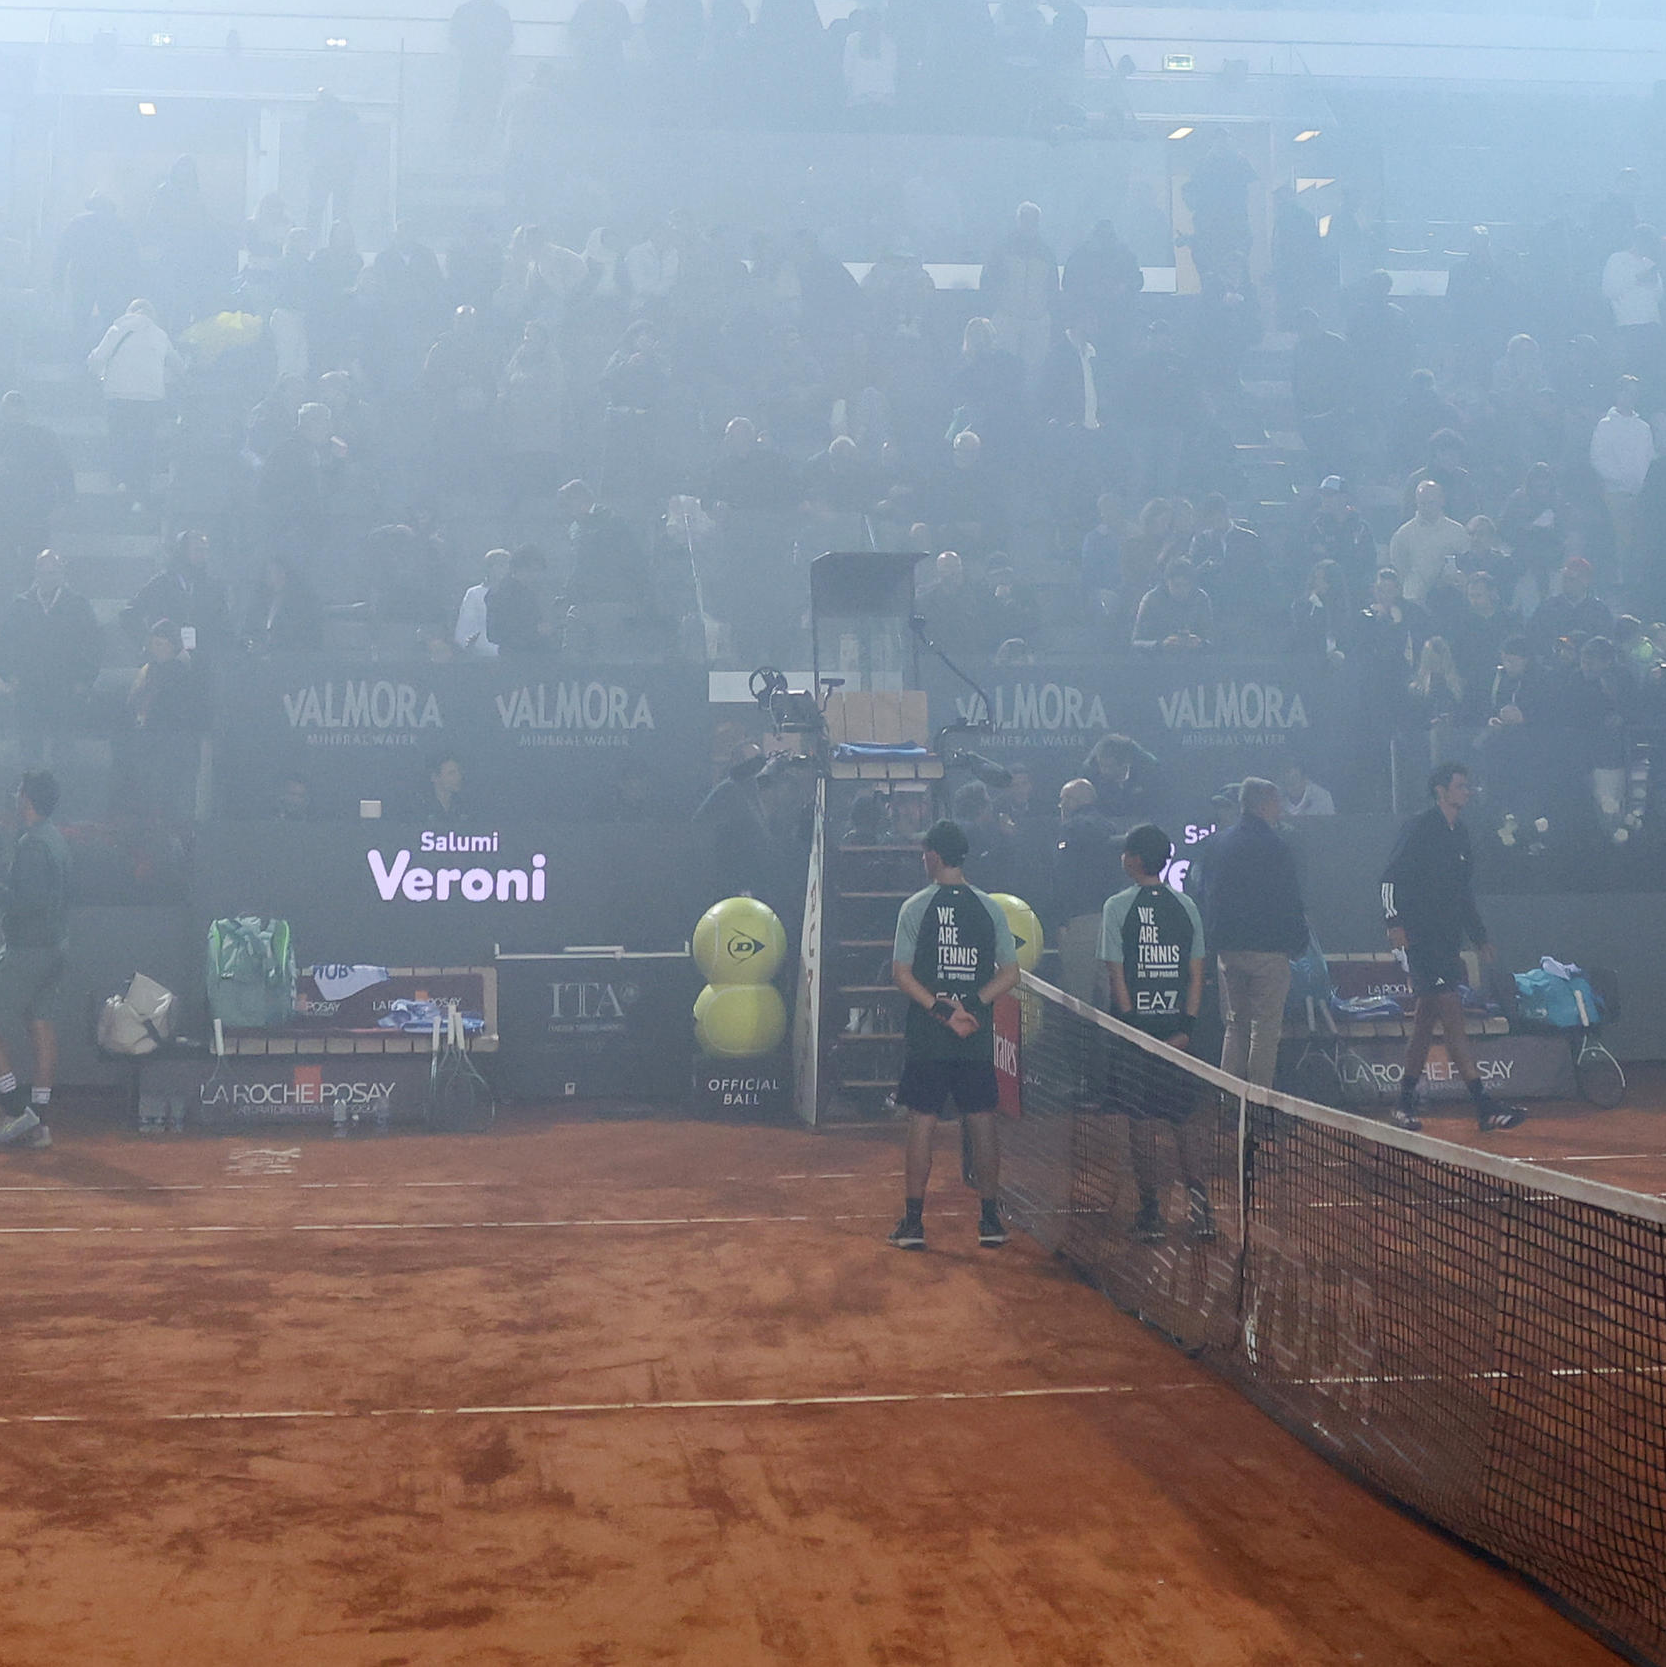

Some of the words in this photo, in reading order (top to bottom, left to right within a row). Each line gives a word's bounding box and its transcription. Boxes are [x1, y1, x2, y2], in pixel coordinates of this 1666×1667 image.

[282, 679, 444, 729] VALMORA
[494, 681, 656, 730] VALMORA
[955, 682, 1110, 730] VALMORA
[1157, 681, 1309, 729] VALMORA
[420, 830, 499, 852] Salumi
[366, 848, 548, 902] Veroni
[937, 906, 955, 926] WE
[1137, 906, 1155, 925] WE
[938, 926, 959, 945] ARE
[1139, 926, 1159, 944] ARE
[938, 946, 978, 966] TENNIS
[1138, 945, 1180, 963] TENNIS
[1367, 984, 1381, 995] LA
[1382, 985, 1412, 995] ROCH
[1136, 990, 1179, 1010] EA7
[992, 1022, 1017, 1077] irates
[1372, 1061, 1447, 1083] ROHE
[1448, 1060, 1515, 1082] PSAY
[200, 1083, 230, 1105] LA
[233, 1083, 315, 1104] ROCHE
[319, 1082, 396, 1103] POSAY
[708, 1079, 779, 1092] OFFICIAL
[723, 1093, 760, 1105] BALL
